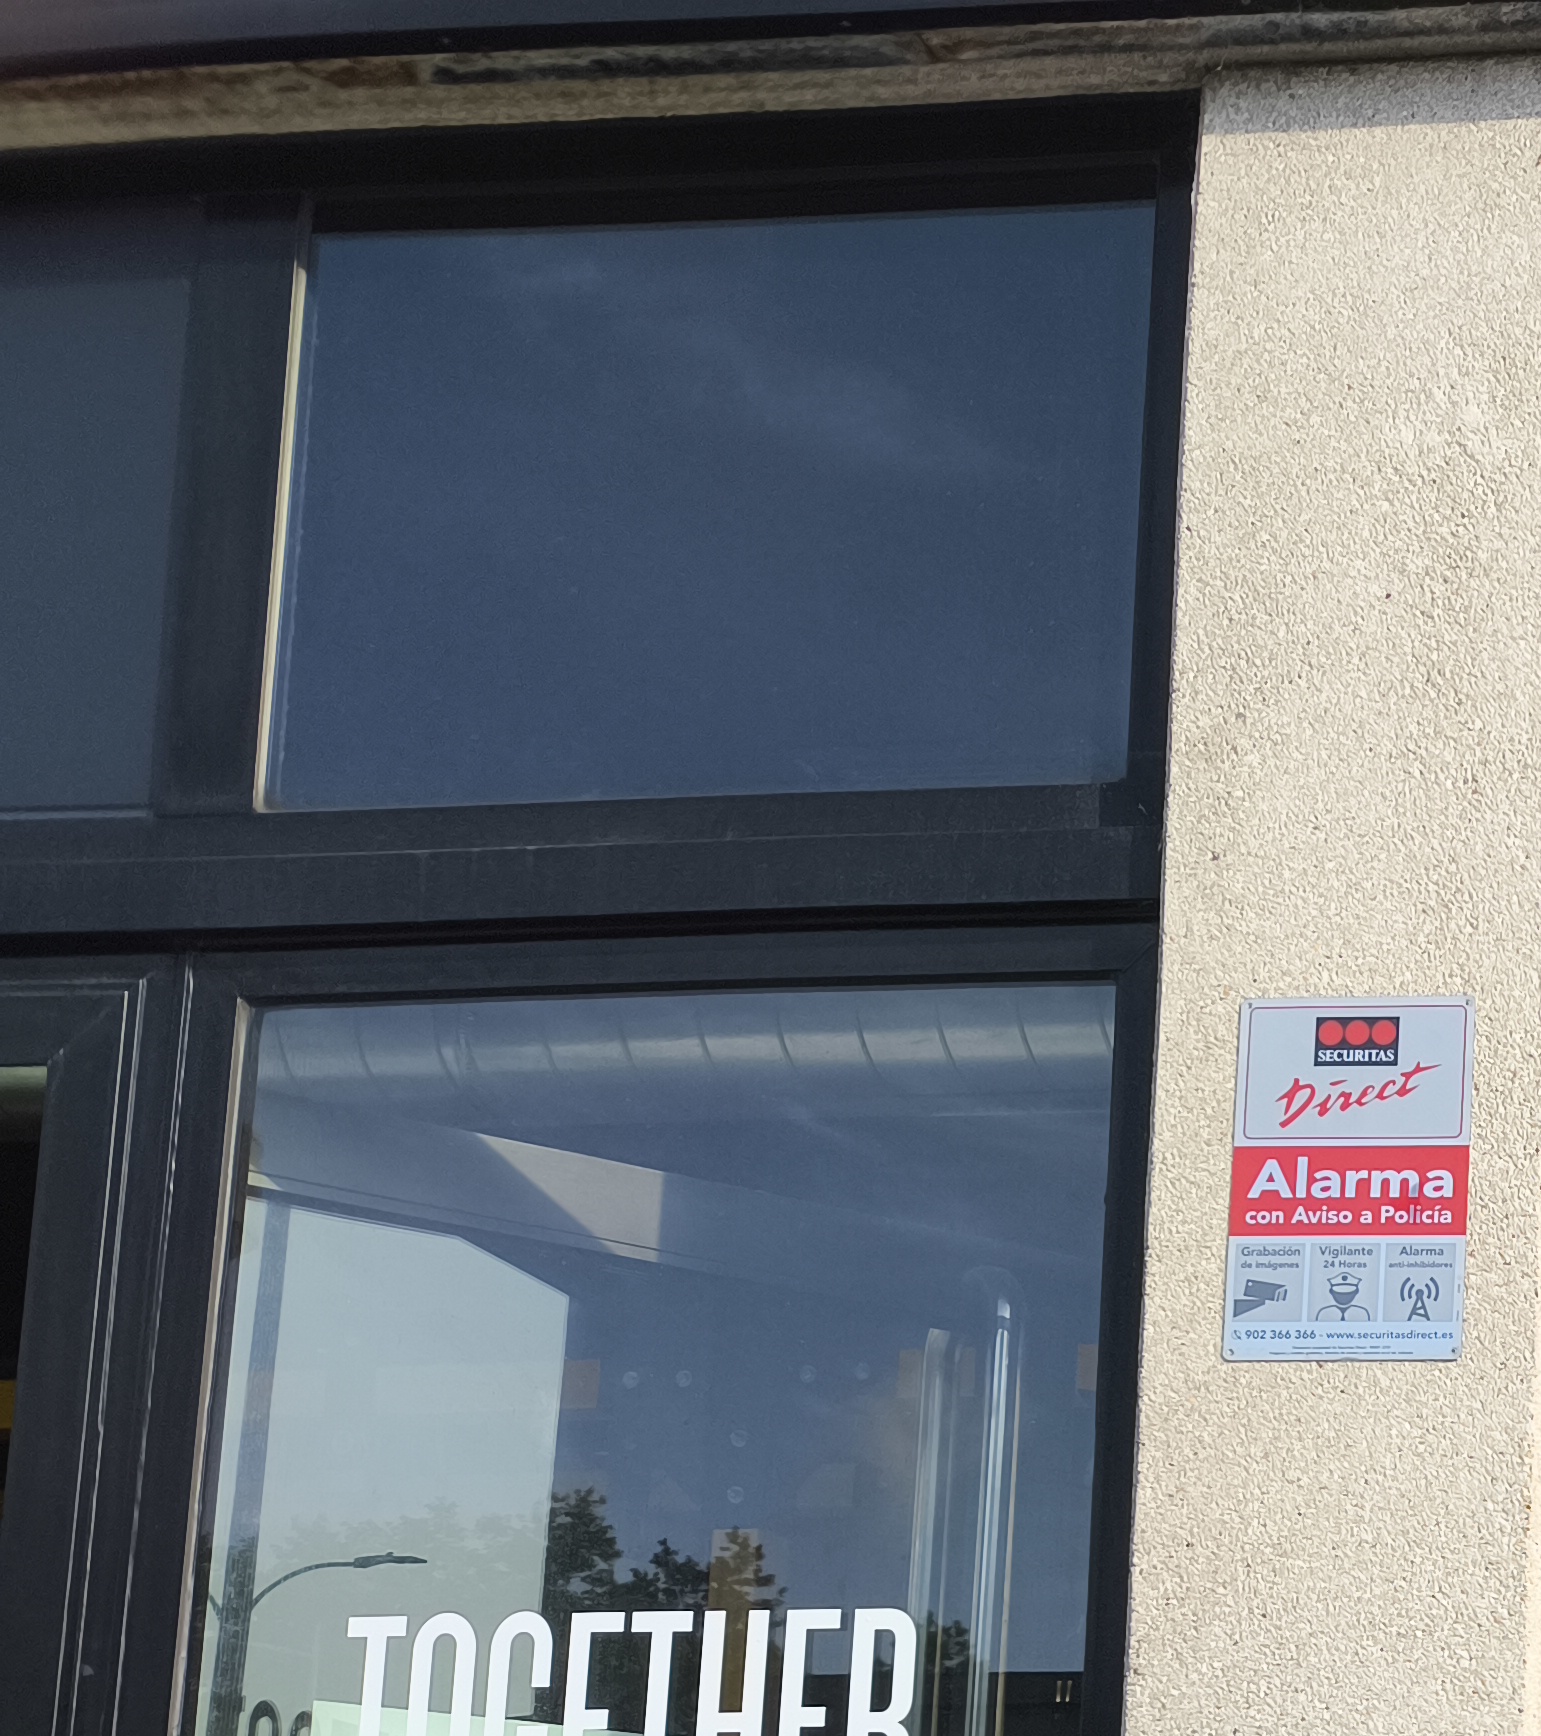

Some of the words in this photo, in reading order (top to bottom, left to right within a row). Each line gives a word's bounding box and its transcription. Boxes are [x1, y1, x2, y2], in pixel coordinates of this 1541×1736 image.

[1317, 1049, 1395, 1063] SECURITAS
[1275, 1061, 1442, 1129] Direct
[1247, 1156, 1454, 1200] Alarma
[1245, 1209, 1284, 1225] con
[1291, 1206, 1353, 1225] Aviso
[1359, 1209, 1373, 1224] a
[1380, 1205, 1453, 1225] Policía
[1240, 1245, 1301, 1259] Grabación
[1318, 1245, 1374, 1260] Vigilante
[1399, 1245, 1444, 1258] Alarma
[1240, 1259, 1252, 1270] de
[1254, 1259, 1300, 1271] imágenes
[1323, 1259, 1336, 1269] 24
[1338, 1259, 1368, 1269] Horas
[1245, 1329, 1267, 1341] 902
[1269, 1329, 1292, 1341] 366
[1294, 1329, 1317, 1341] 366
[1325, 1329, 1454, 1342] www.securitasdirect.es
